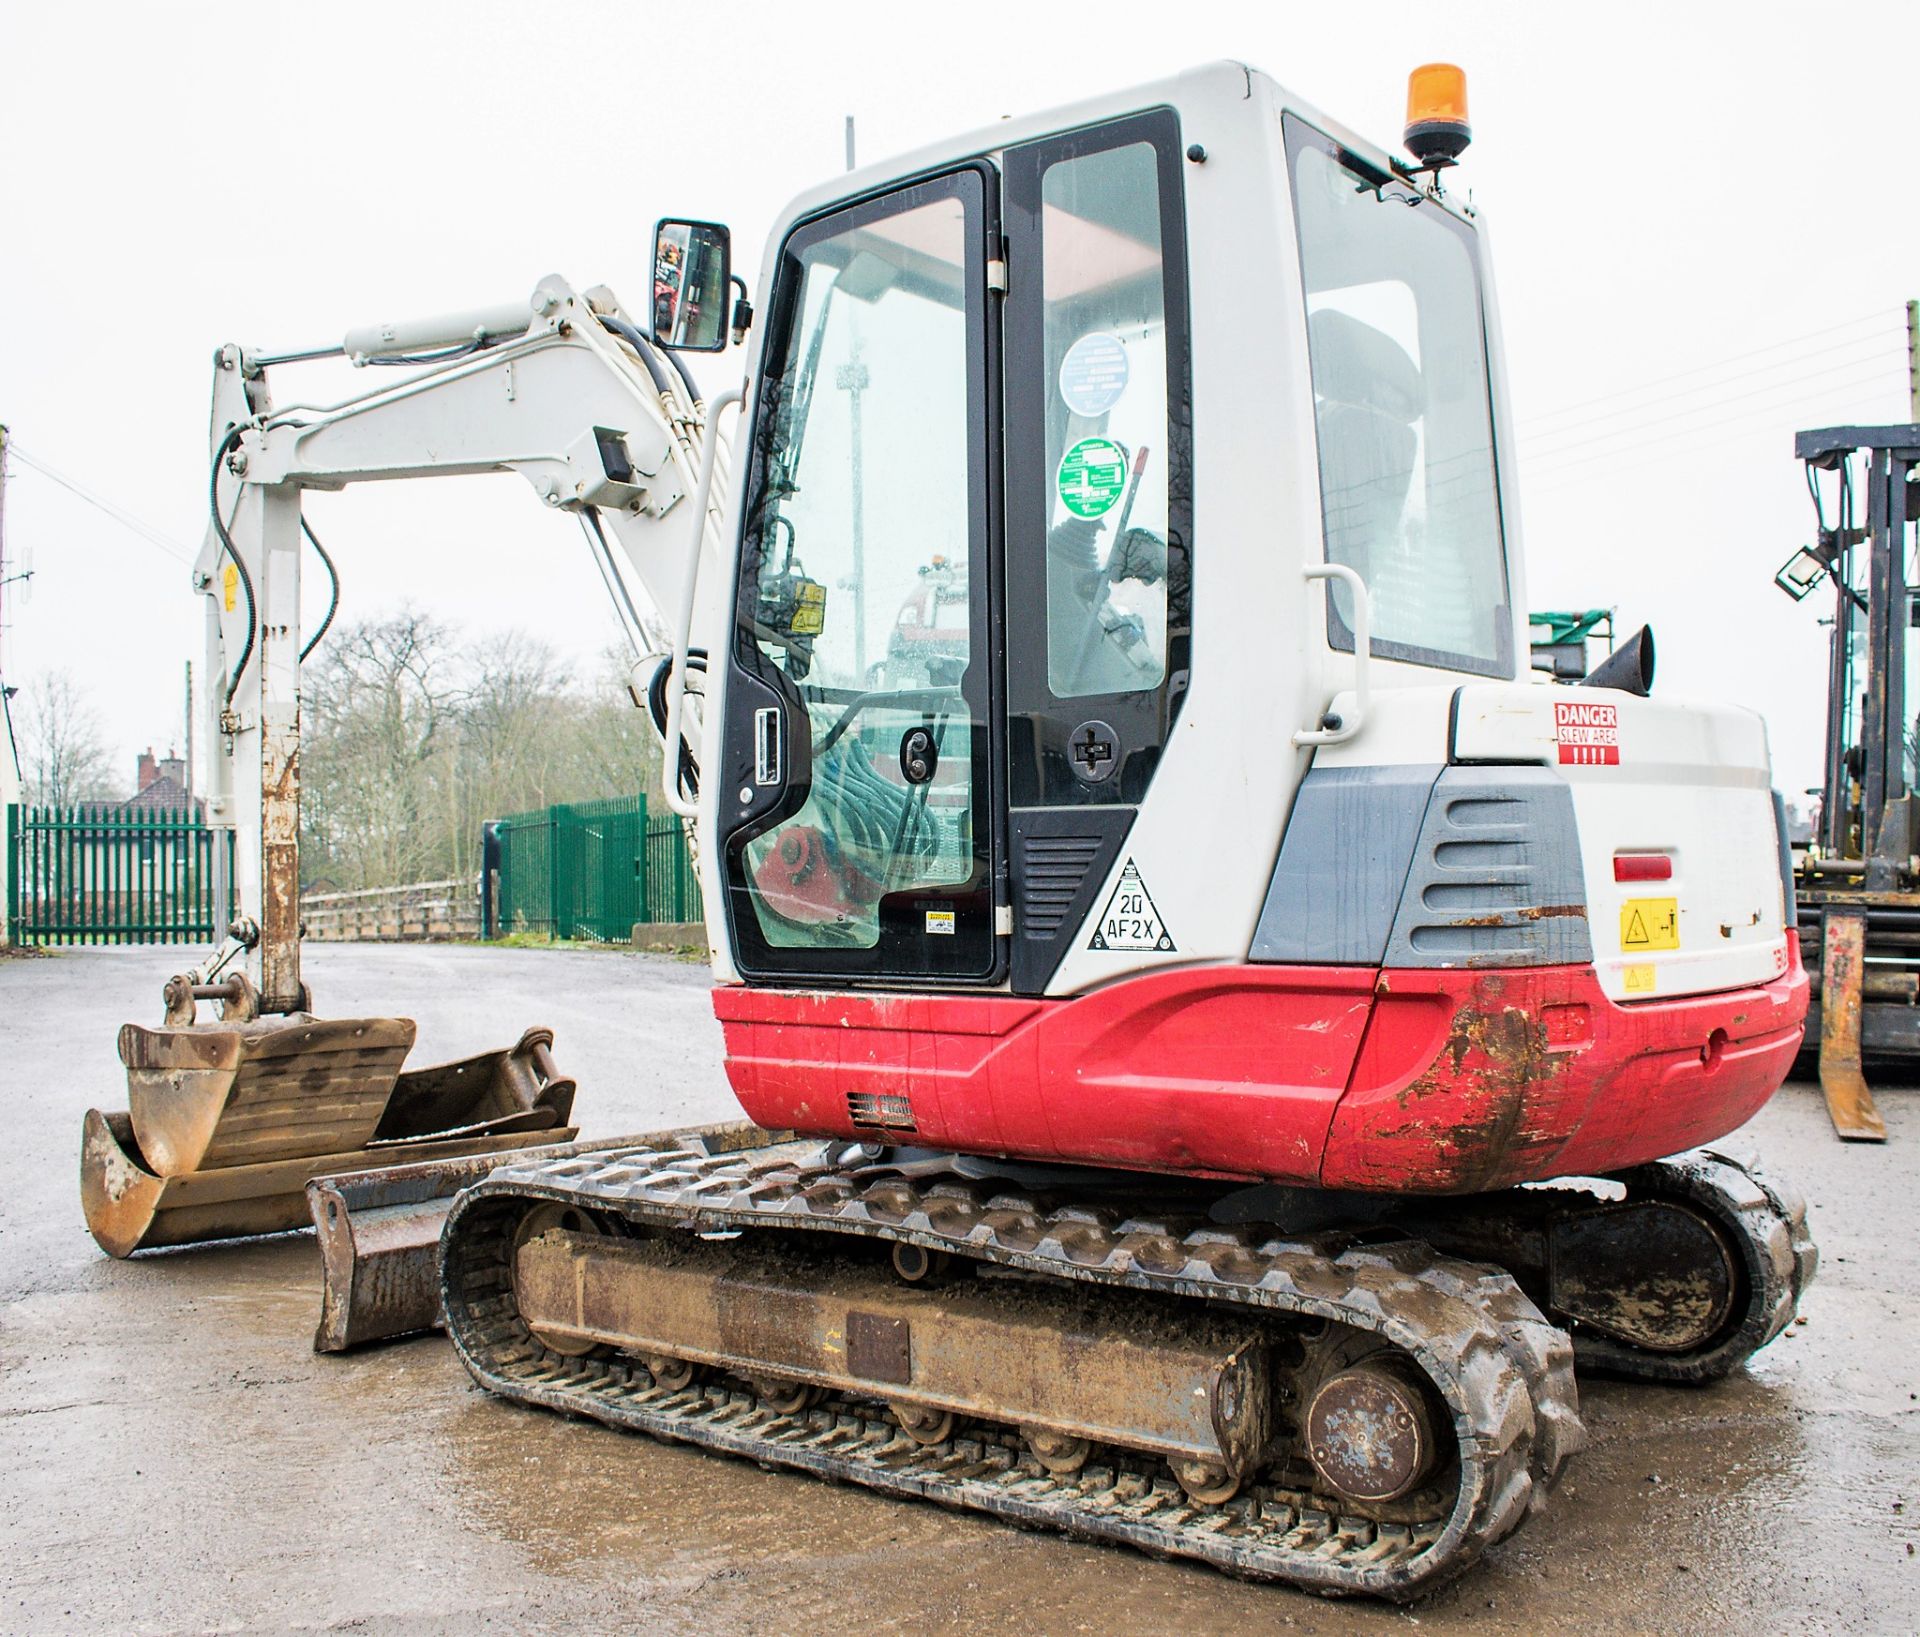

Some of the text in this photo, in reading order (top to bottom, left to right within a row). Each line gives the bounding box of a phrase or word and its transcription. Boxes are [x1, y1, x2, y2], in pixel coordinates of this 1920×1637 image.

[1557, 705, 1616, 726] DANGER
[1561, 728, 1617, 744] SLEW AREA
[1107, 919, 1154, 939] AF2X
